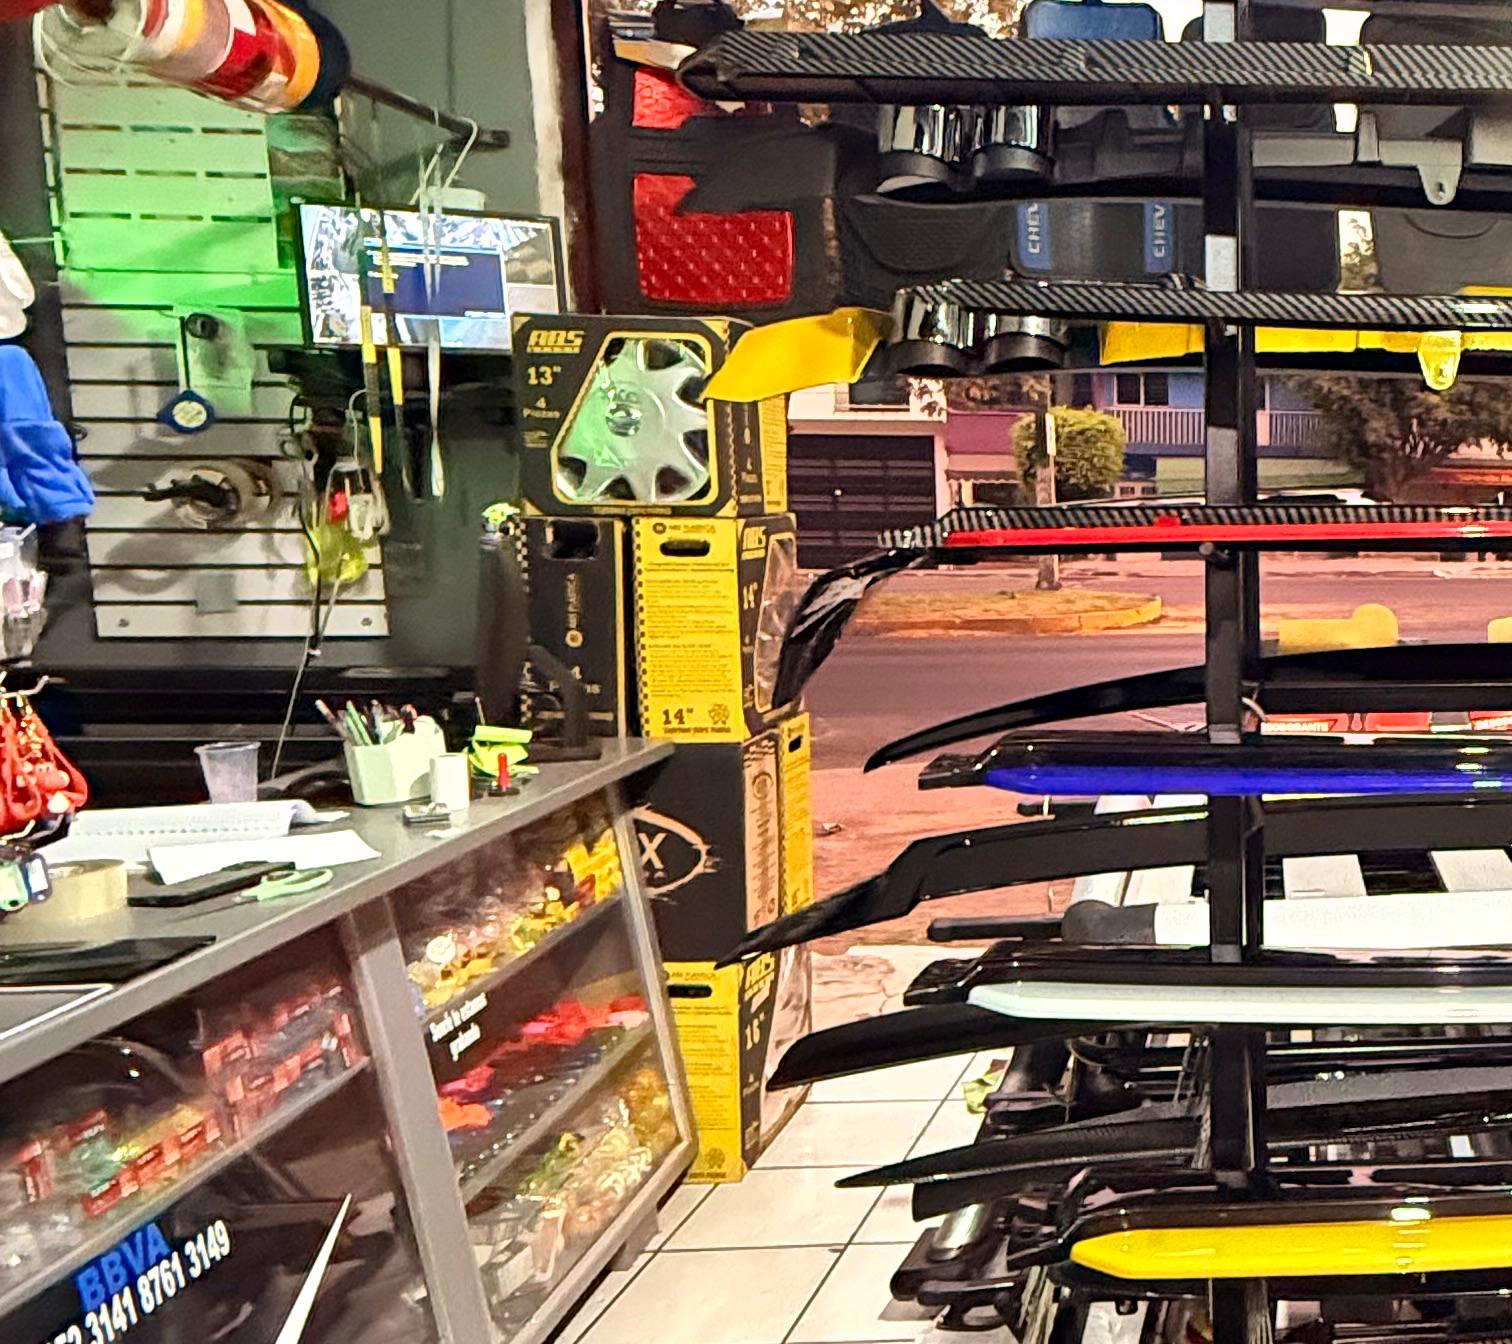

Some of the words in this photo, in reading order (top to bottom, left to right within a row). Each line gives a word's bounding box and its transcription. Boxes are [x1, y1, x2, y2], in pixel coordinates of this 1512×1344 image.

[528, 365, 562, 385] 13"
[662, 707, 694, 725] 14"
[77, 1221, 171, 1313] BBVA
[136, 1251, 187, 1315] 8761
[184, 1219, 232, 1279] 3149
